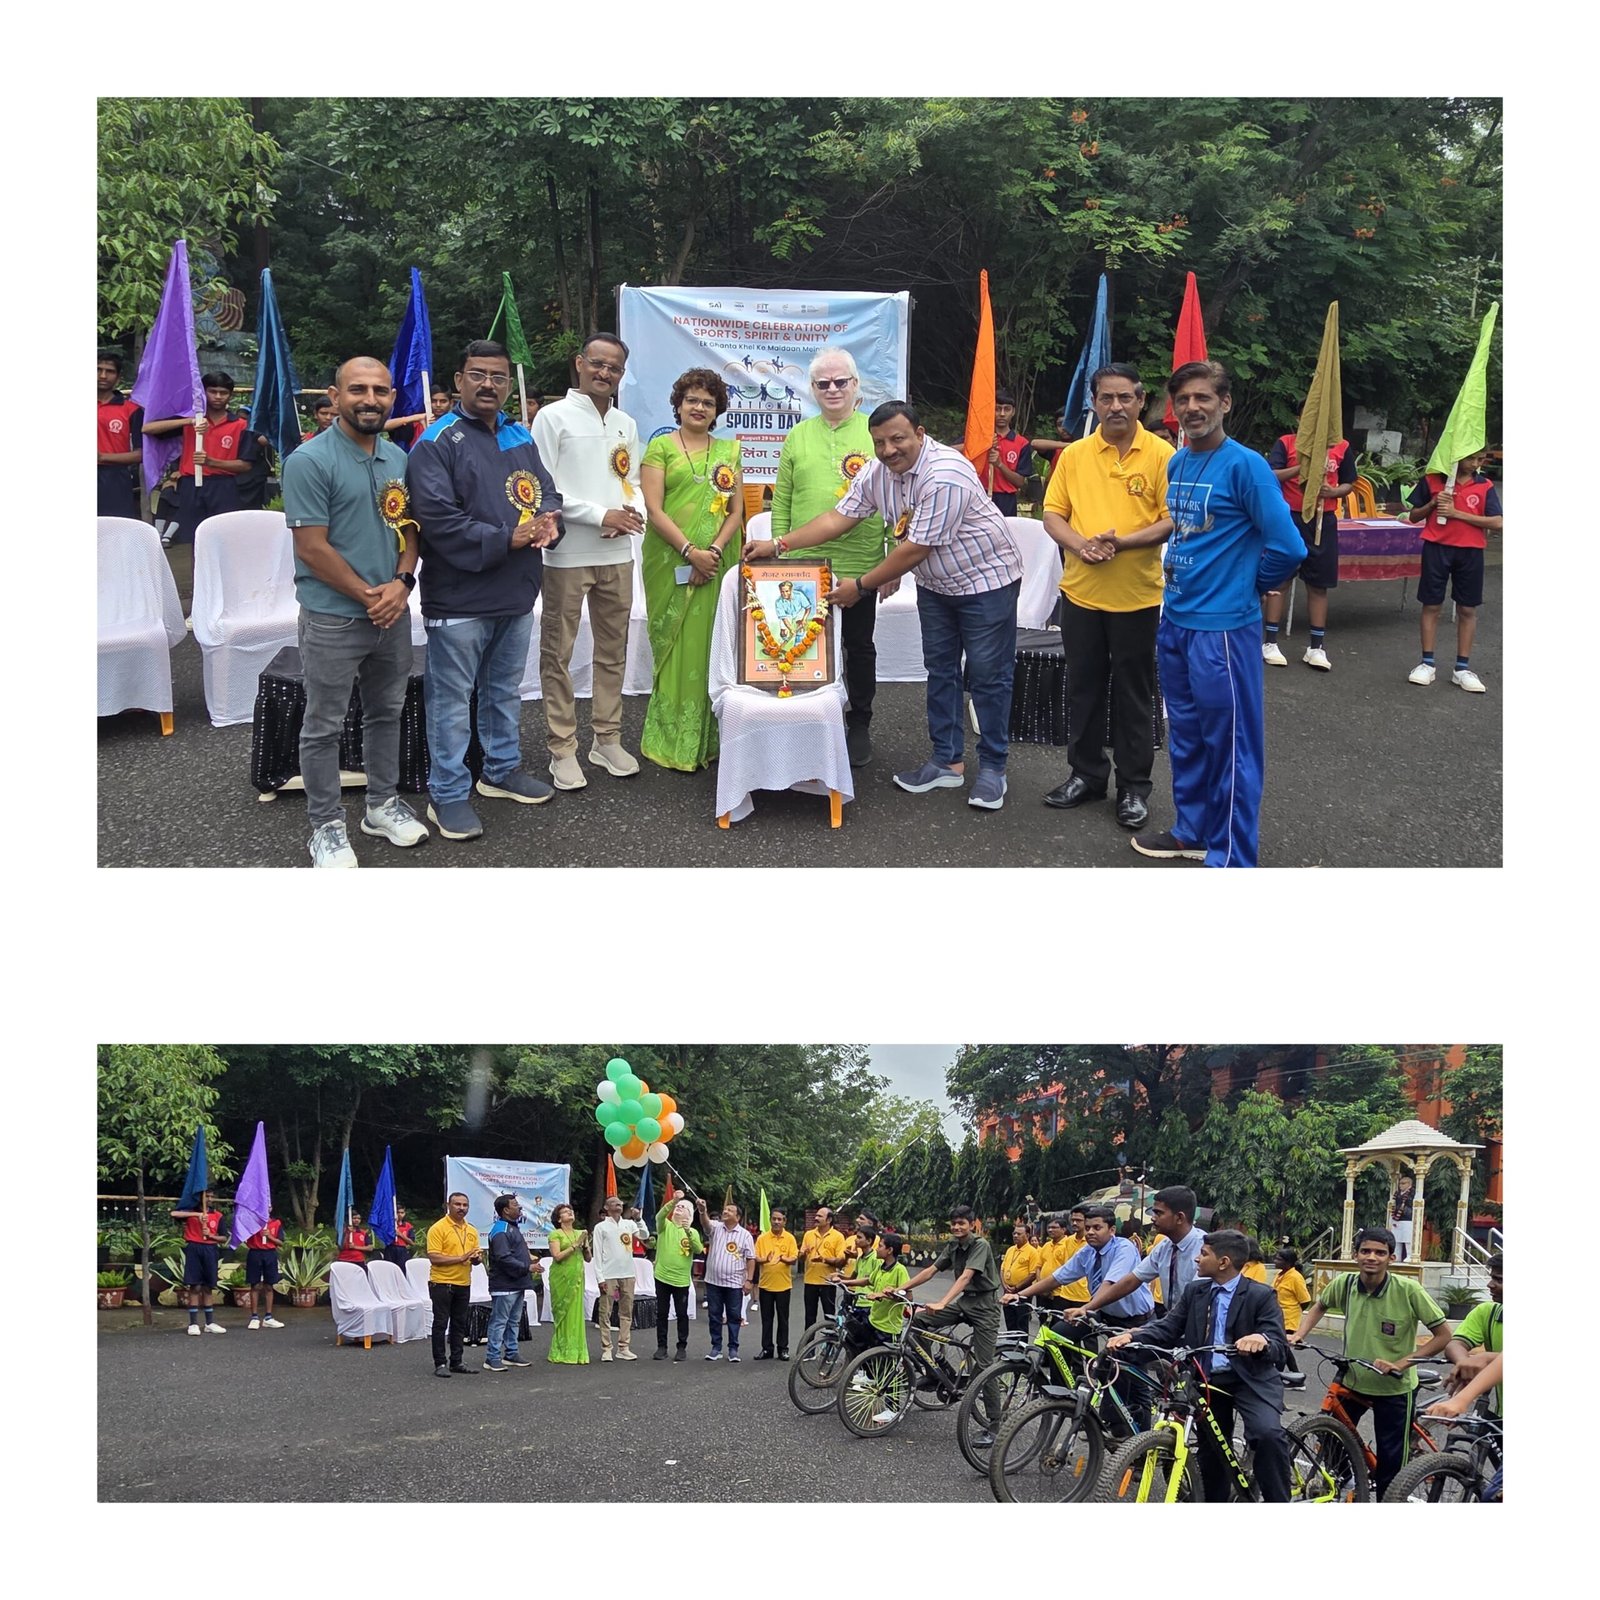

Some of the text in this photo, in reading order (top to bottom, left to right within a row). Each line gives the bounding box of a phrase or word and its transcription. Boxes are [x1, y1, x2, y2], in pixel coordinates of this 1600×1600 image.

[673, 316, 849, 333] NATIONWIDE CELEBRATION OF
[693, 328, 829, 342] SPORTS, SPIRIT & UNITY
[767, 344, 801, 352] Maidaan
[726, 413, 802, 430] SPORTS DAY
[741, 434, 761, 442] August
[741, 446, 768, 459] लिंग
